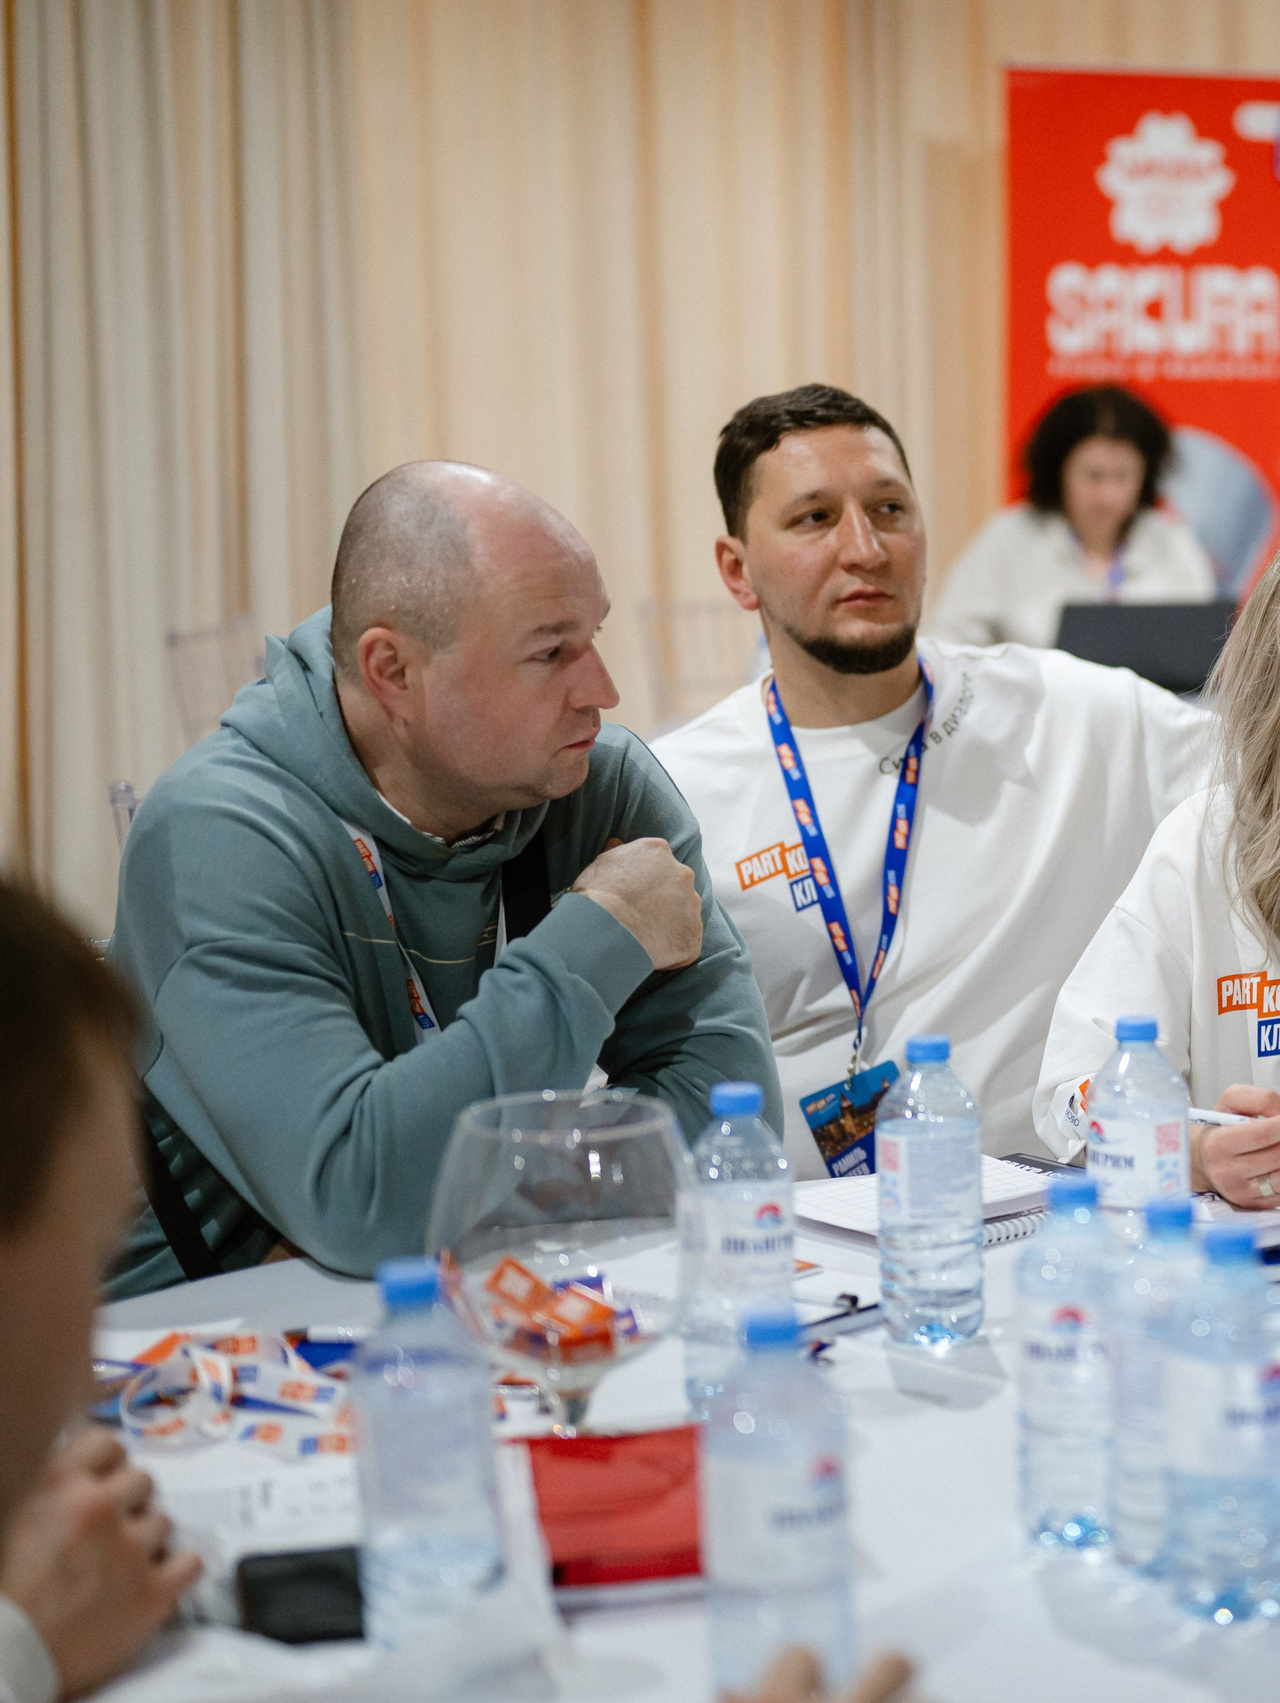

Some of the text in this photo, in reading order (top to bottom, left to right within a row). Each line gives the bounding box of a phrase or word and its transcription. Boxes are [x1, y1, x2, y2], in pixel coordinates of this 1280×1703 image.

[740, 846, 783, 885] PART
[785, 846, 809, 875] KO
[792, 877, 818, 908] КЛ
[1222, 977, 1261, 1008] PART
